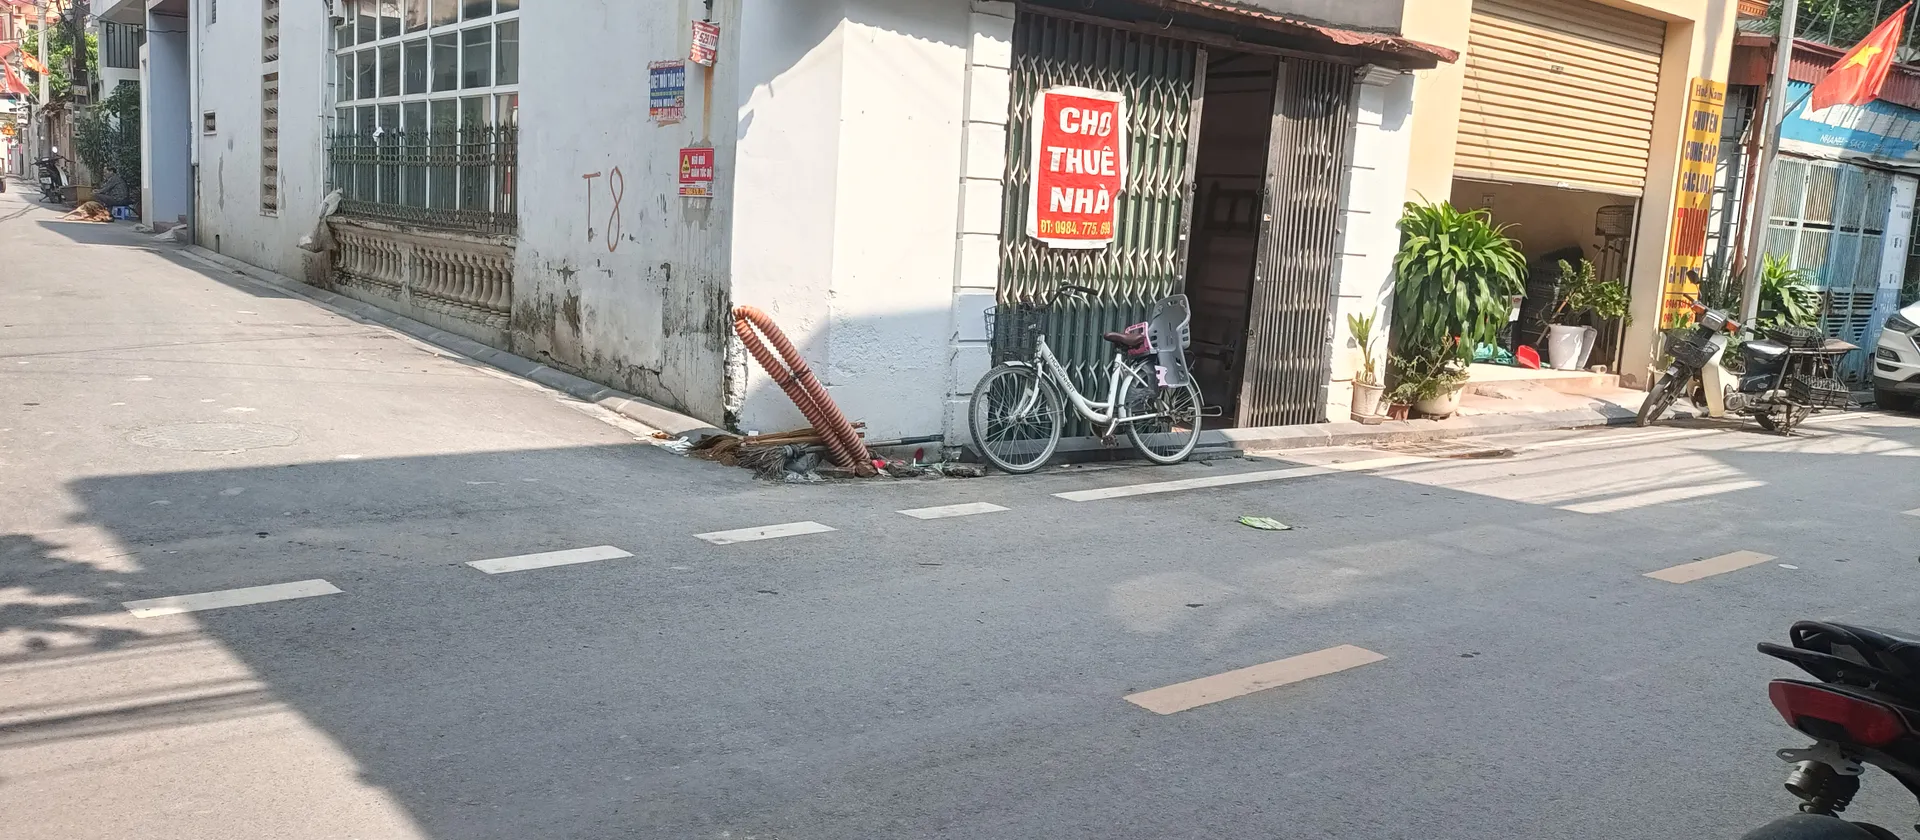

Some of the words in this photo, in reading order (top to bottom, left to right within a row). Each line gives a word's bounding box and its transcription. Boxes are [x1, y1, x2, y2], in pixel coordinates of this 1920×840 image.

[1059, 106, 1112, 137] CHO
[1692, 110, 1719, 133] CHUYÊN
[1047, 145, 1116, 177] THUÊ
[1685, 141, 1703, 162] CUNG
[1682, 169, 1696, 192] CÁC
[1696, 173, 1712, 194] LOẠI
[1049, 184, 1110, 215] NHÀ
[1081, 221, 1098, 236] 775.
[1674, 196, 1708, 257] TRỨNG
